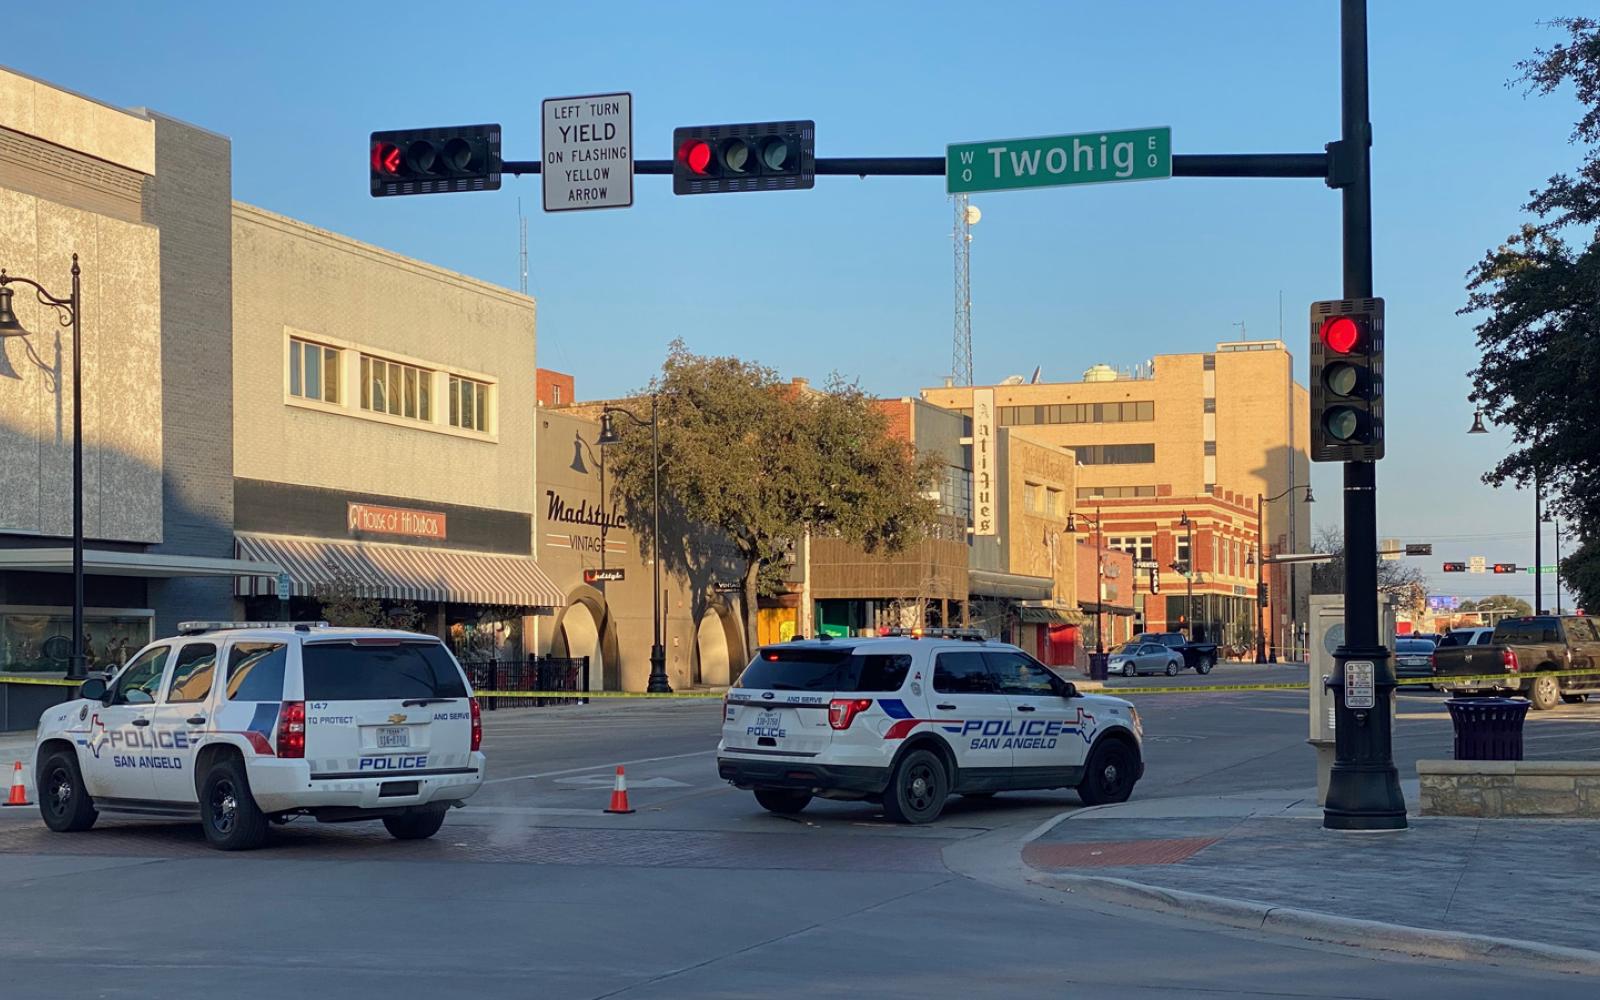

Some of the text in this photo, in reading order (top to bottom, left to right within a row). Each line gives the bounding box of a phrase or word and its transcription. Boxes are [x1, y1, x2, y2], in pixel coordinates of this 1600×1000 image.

[554, 102, 619, 120] LEFT TURN
[558, 122, 616, 144] YIELD
[1148, 136, 1156, 150] E
[548, 146, 626, 164] ON FLASHING
[960, 151, 974, 164] W
[988, 135, 1134, 178] Twohig
[565, 167, 610, 182] YELLOW
[568, 188, 608, 202] ARROW
[546, 490, 626, 537] Madstyle
[569, 534, 606, 554] VINTAGE
[747, 727, 787, 737] POLICE
[962, 720, 1064, 736] POLICE
[110, 730, 189, 749] POLICE
[970, 738, 1057, 750] SAN ANGELO
[114, 756, 182, 769] SAN ANGELO
[360, 757, 428, 770] POLICE
